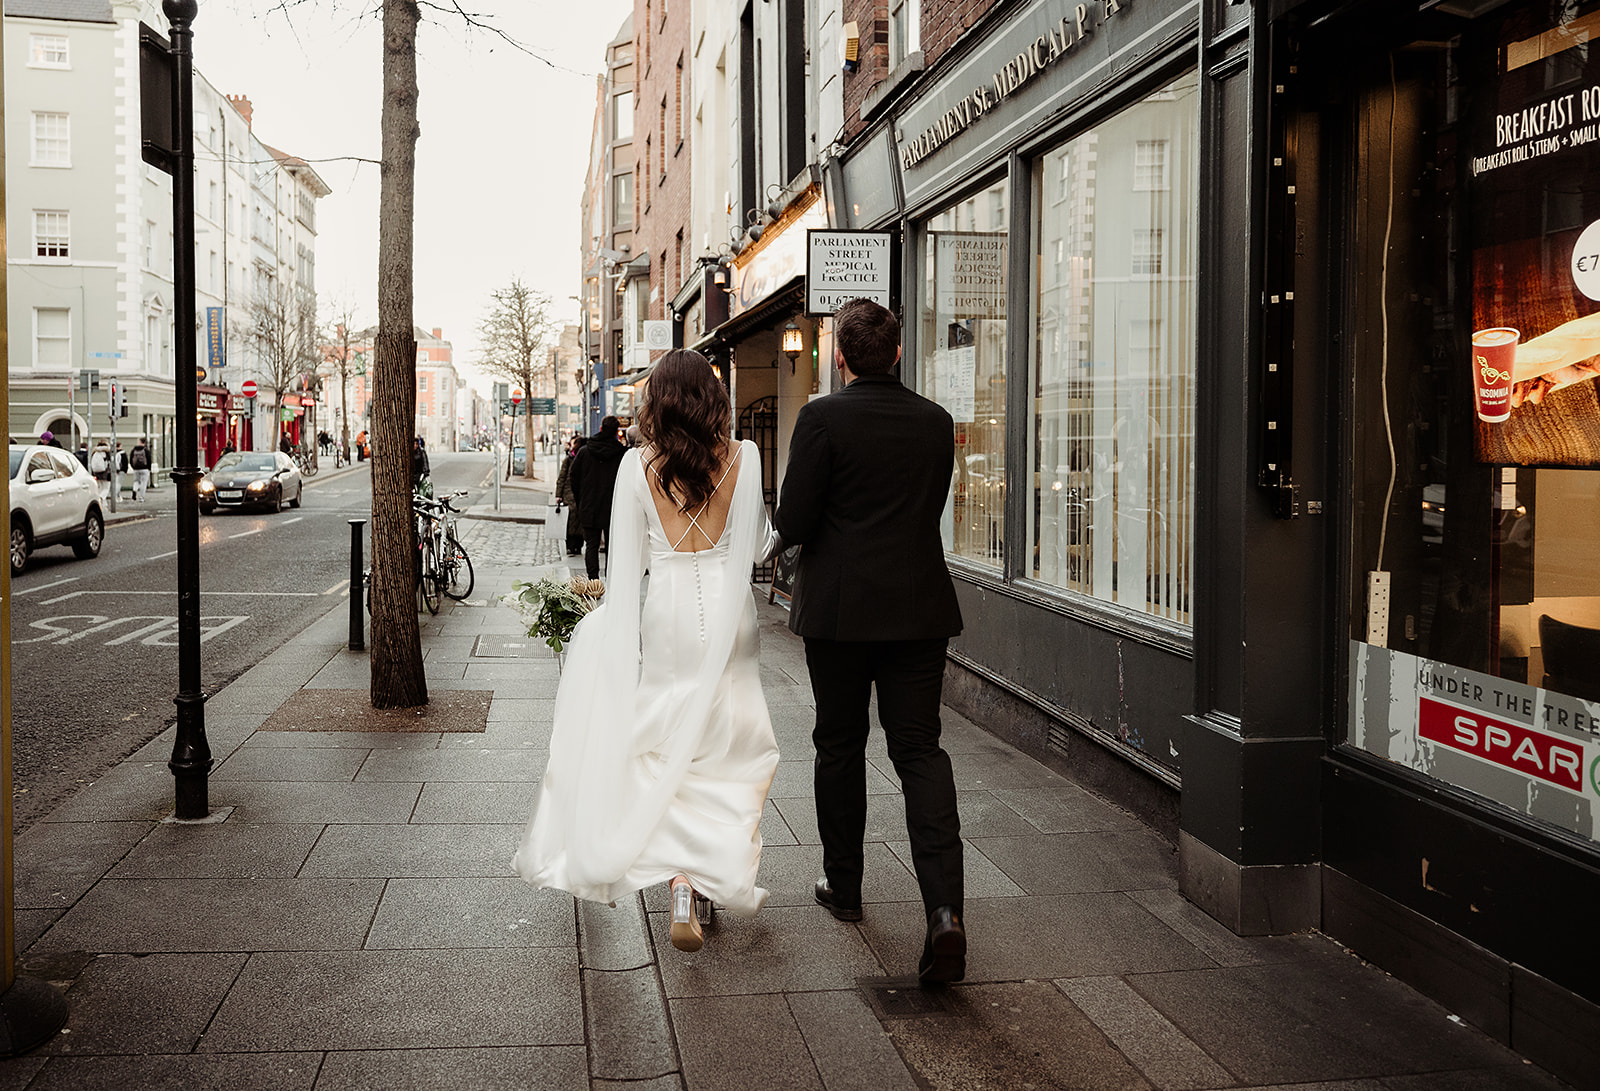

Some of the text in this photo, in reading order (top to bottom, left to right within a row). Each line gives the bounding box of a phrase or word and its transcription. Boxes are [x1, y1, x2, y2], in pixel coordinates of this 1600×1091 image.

[901, 95, 970, 172] PARLIAMENT
[993, 17, 1072, 102] MEDICAL
[1496, 94, 1574, 147] BREAKFAST
[1472, 149, 1511, 177] (BREAKFAST
[1511, 144, 1529, 163] ROLL
[1569, 124, 1597, 147] SMALL
[814, 237, 887, 247] PARLIAMENT
[829, 249, 872, 259] STREET
[1420, 670, 1482, 702] UNDER
[1493, 690, 1532, 716] THE
[1454, 716, 1579, 782] SPAR
